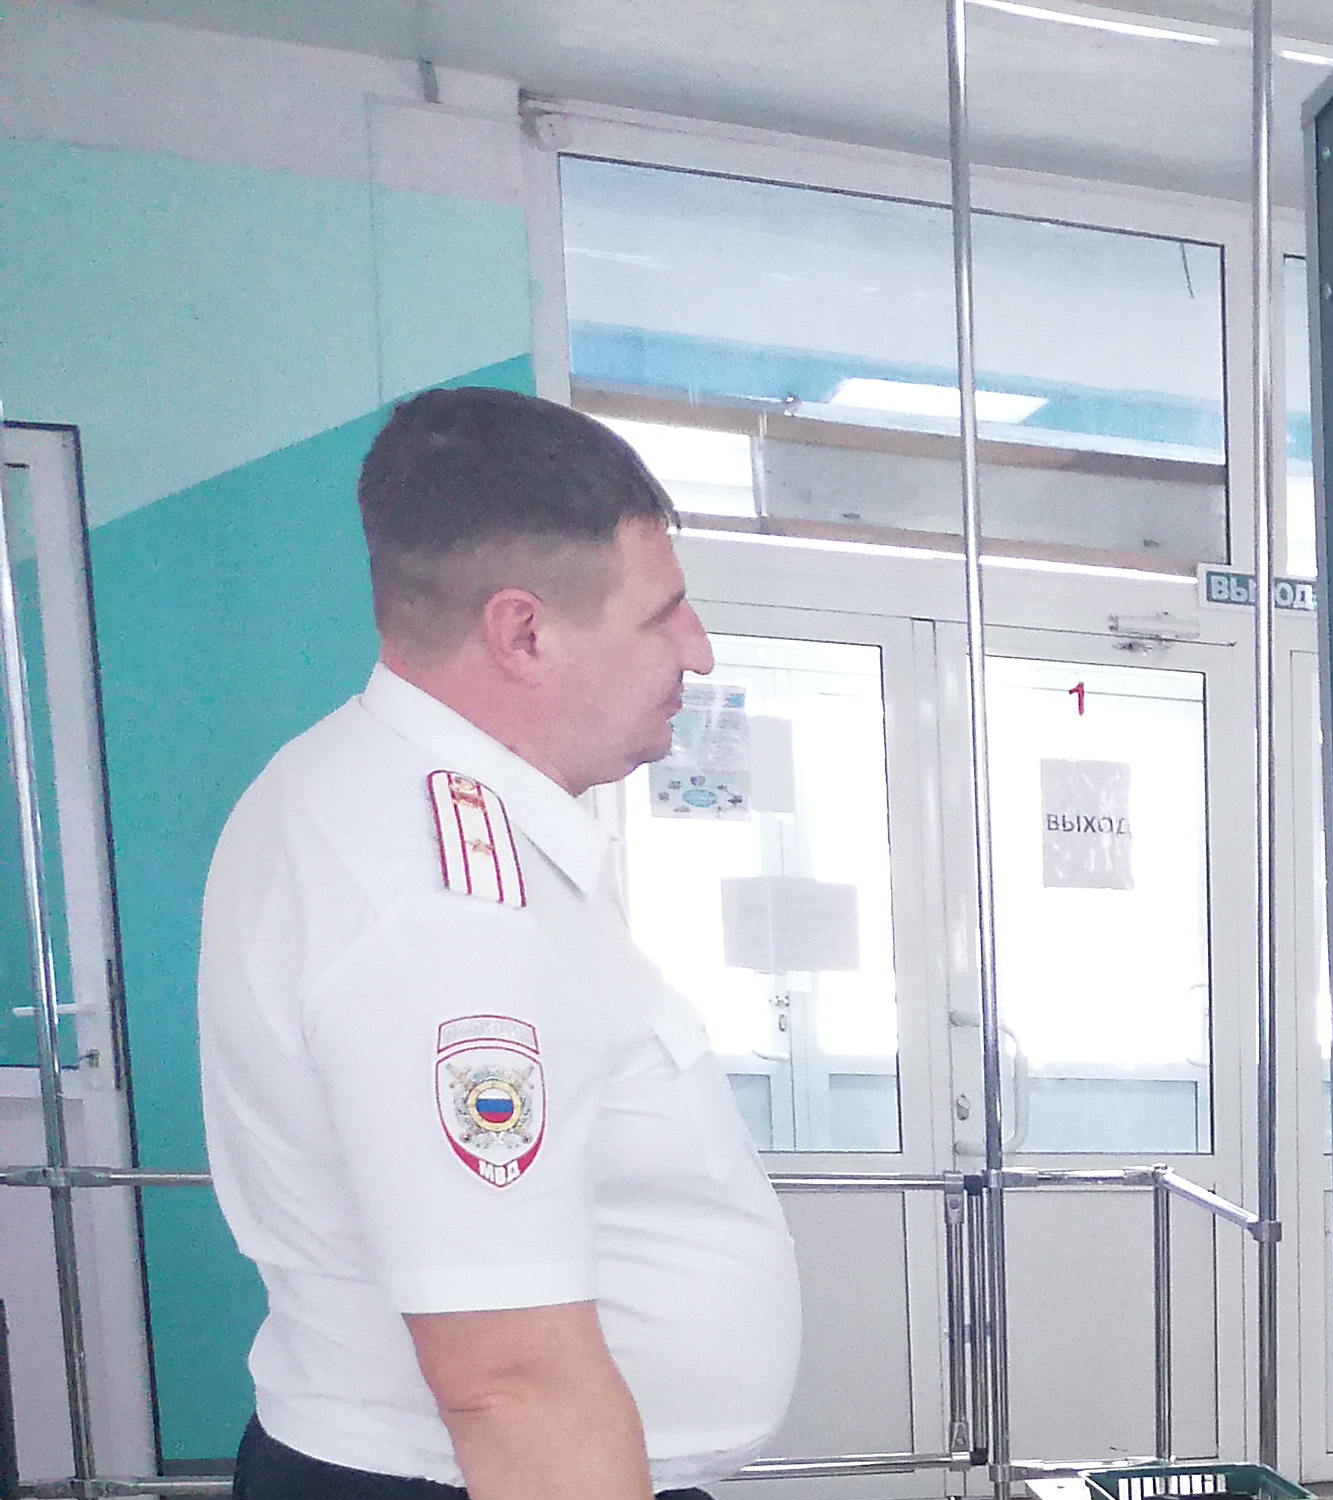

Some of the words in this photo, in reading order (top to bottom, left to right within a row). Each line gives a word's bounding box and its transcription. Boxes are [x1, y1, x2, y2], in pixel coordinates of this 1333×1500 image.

[1210, 575, 1314, 608] ВЫОД
[1068, 681, 1085, 717] 1
[1046, 814, 1131, 835] ВЫХОД
[478, 1160, 520, 1186] МВД
